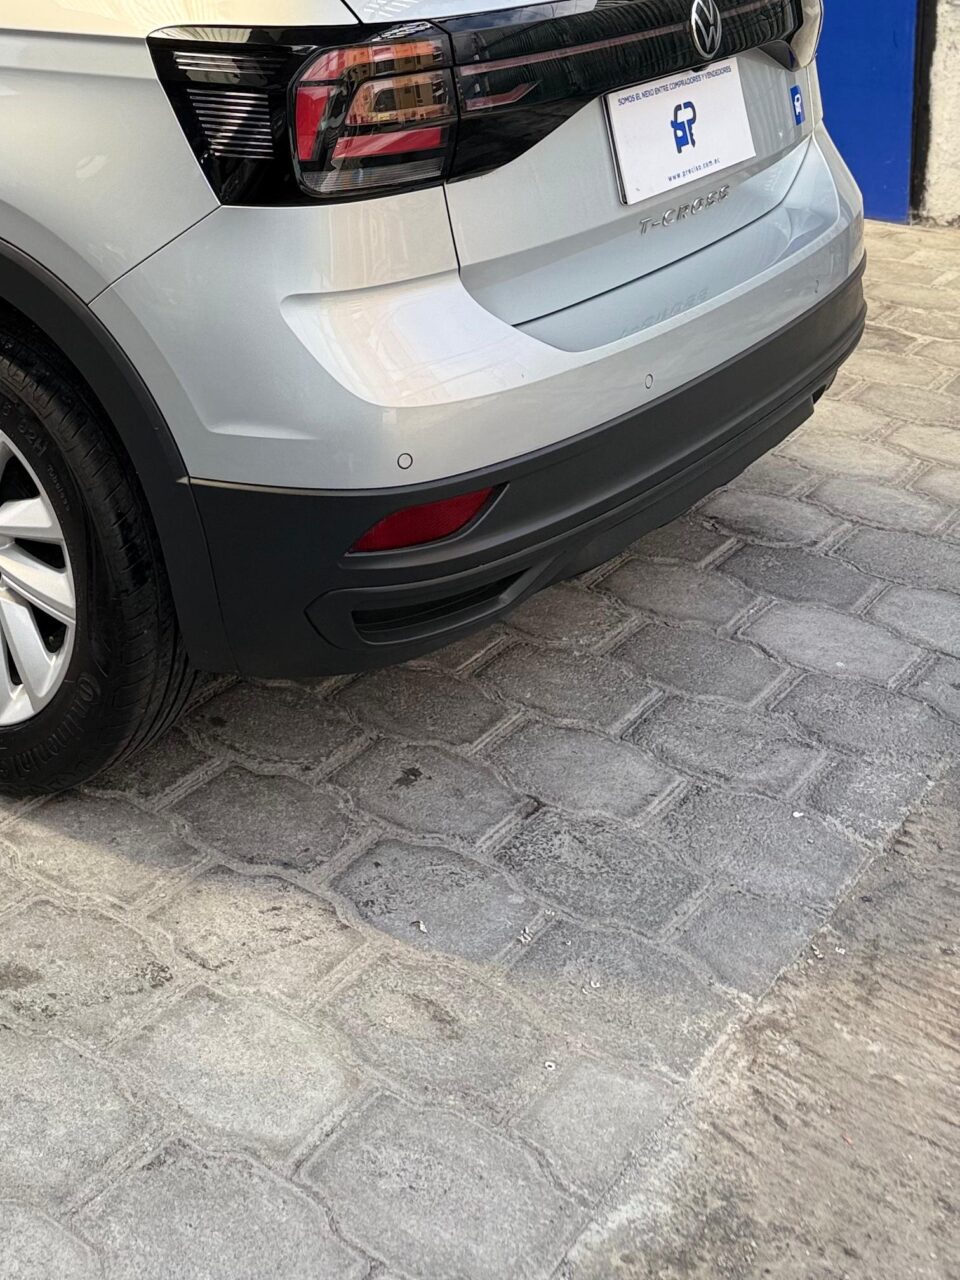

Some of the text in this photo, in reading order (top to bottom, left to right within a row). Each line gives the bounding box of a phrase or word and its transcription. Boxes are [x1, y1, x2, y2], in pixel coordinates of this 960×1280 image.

[618, 95, 635, 106] SOMOS
[654, 83, 670, 96] ENTRE
[669, 75, 702, 90] COMPRADORES
[704, 64, 732, 80] VENDEDORES
[639, 183, 730, 236] T-CROSS
